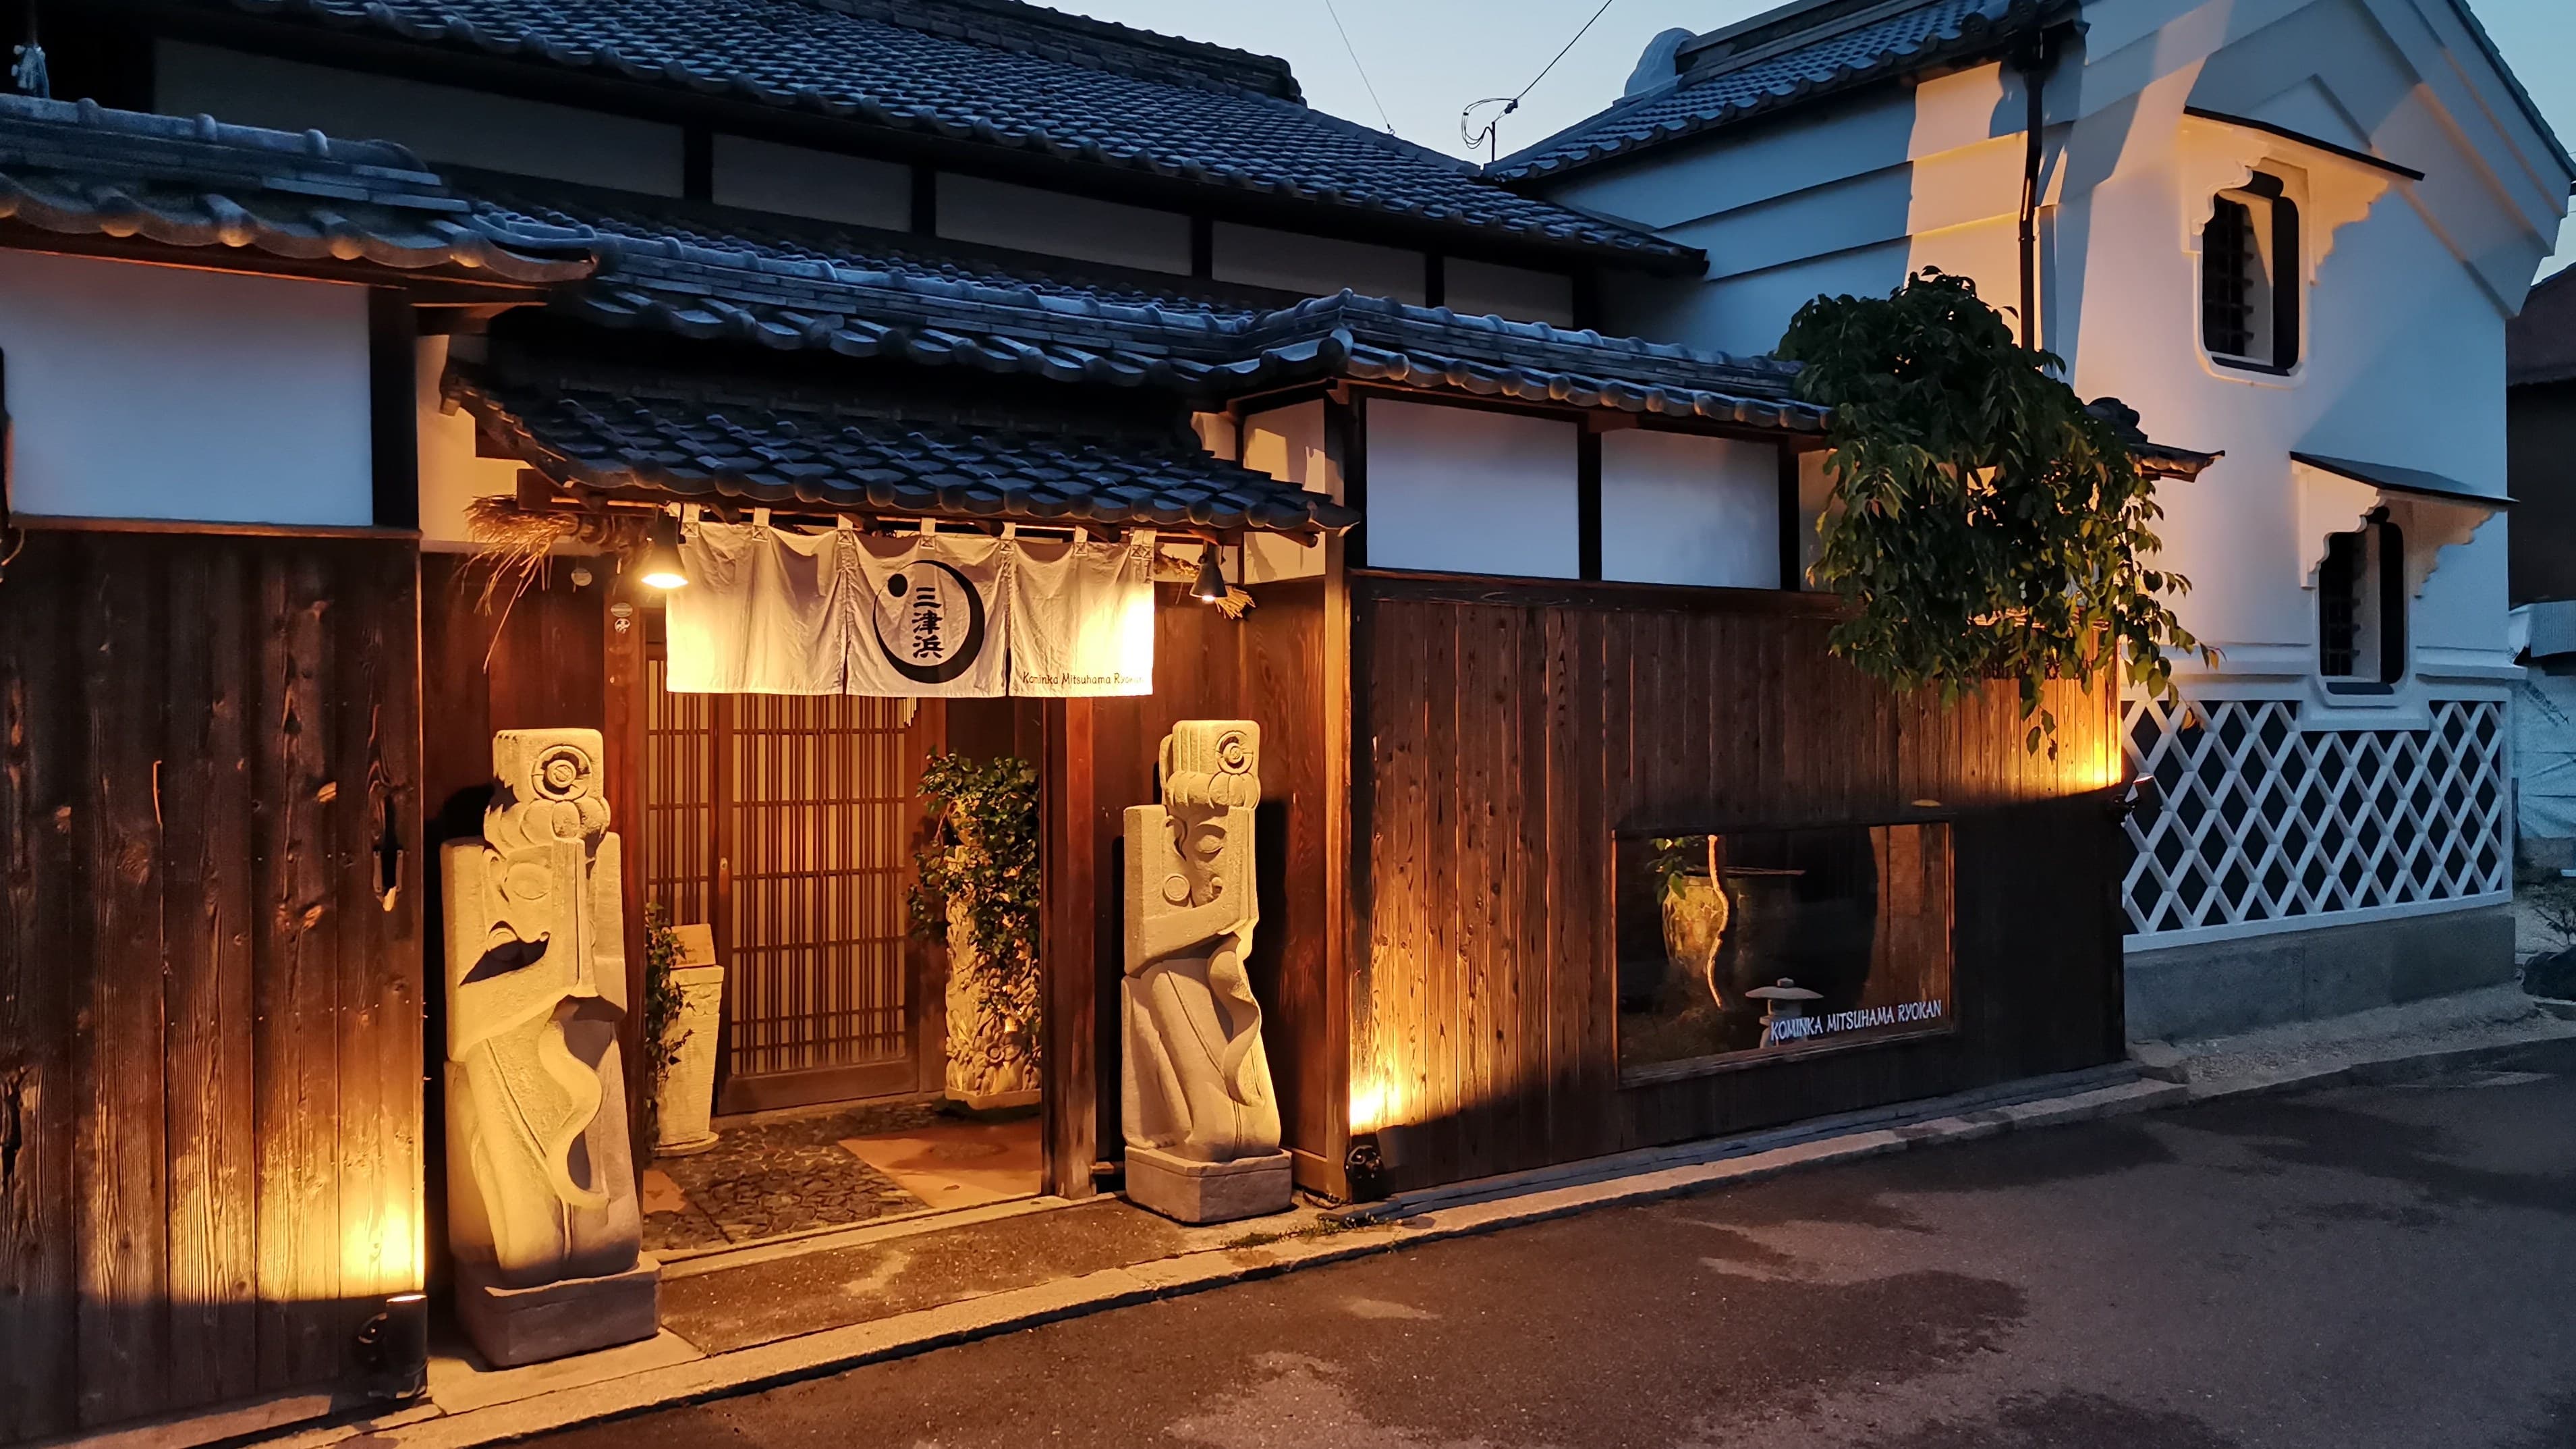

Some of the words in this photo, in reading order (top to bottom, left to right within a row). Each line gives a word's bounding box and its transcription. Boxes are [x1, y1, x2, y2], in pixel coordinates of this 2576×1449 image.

[912, 586, 945, 659] 三津浜
[1061, 672, 1111, 685] Mitsuhama
[1770, 1015, 1823, 1041] KOMINKA
[1826, 1006, 1895, 1033] MITSUHAMA
[1897, 999, 1942, 1022] RYOKAN
